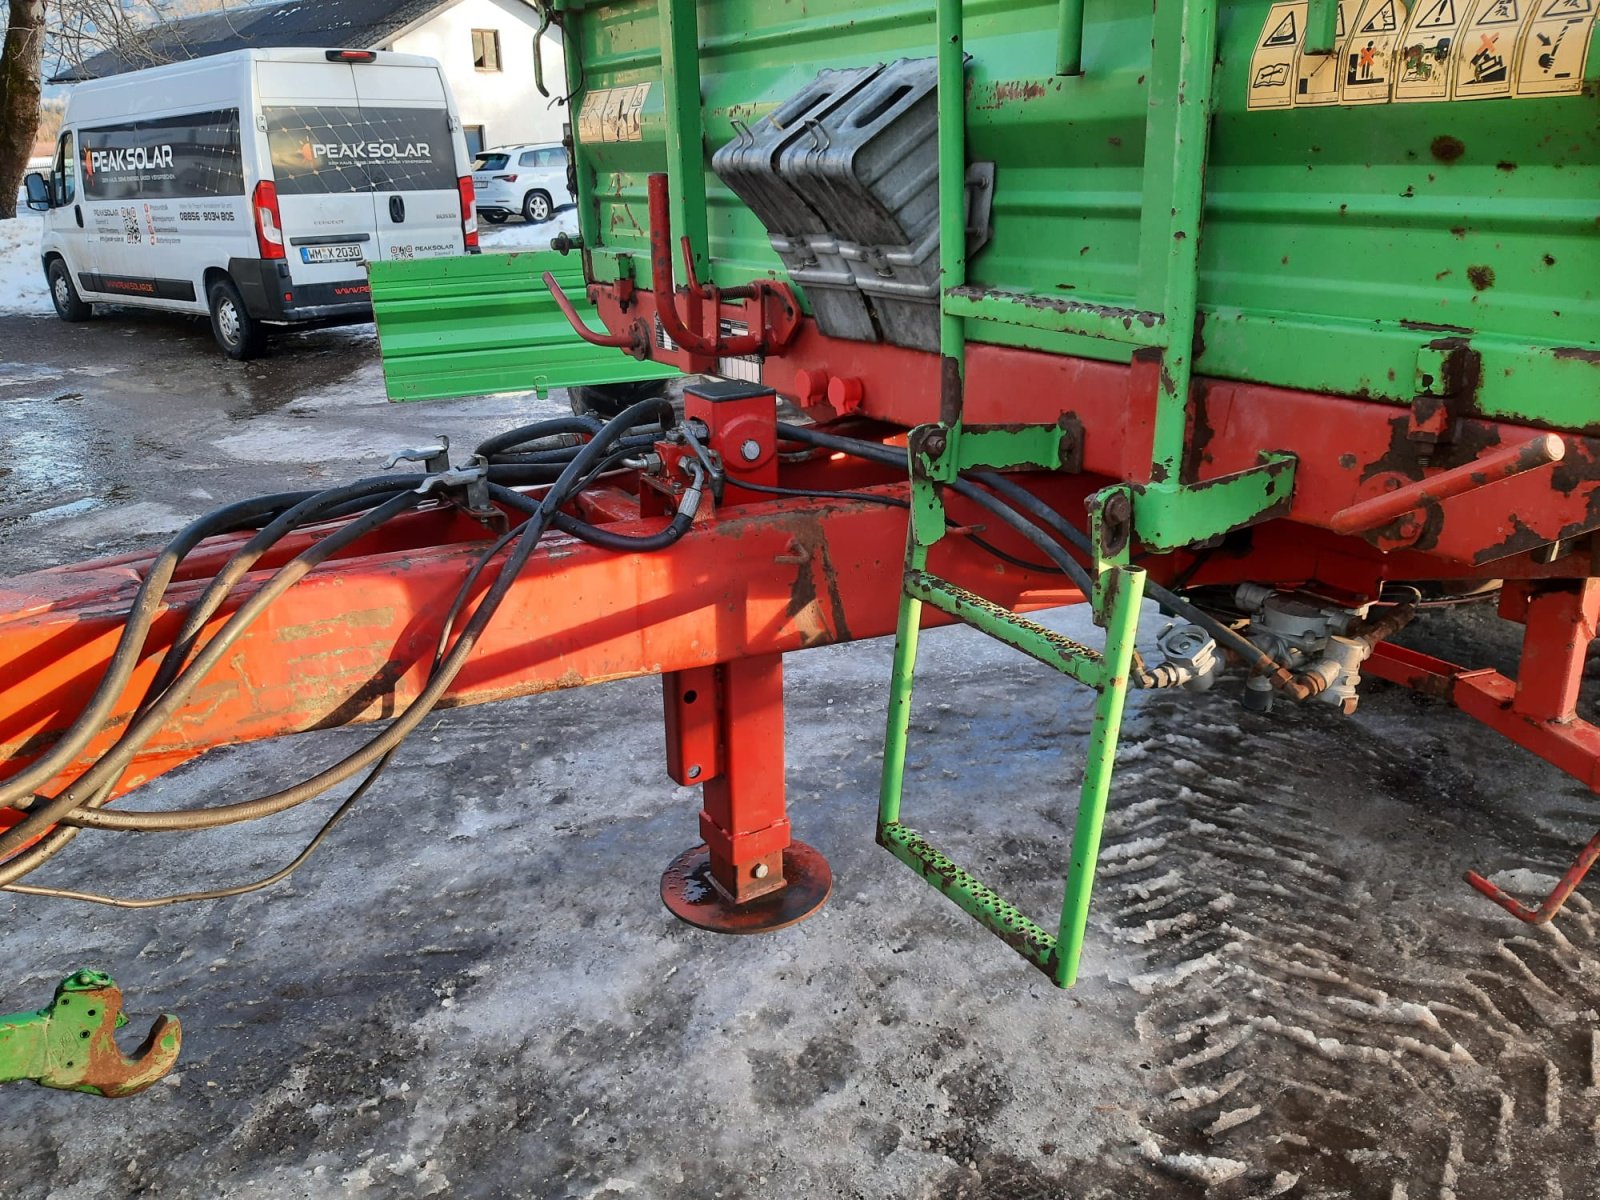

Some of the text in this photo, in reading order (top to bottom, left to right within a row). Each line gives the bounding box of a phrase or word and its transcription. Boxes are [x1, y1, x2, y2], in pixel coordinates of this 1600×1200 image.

[179, 211, 201, 221] 08856
[203, 211, 220, 221] 9034
[414, 243, 454, 251] PEAKSOLAR
[308, 247, 322, 260] WM
[327, 247, 335, 259] X
[337, 245, 360, 258] 2030
